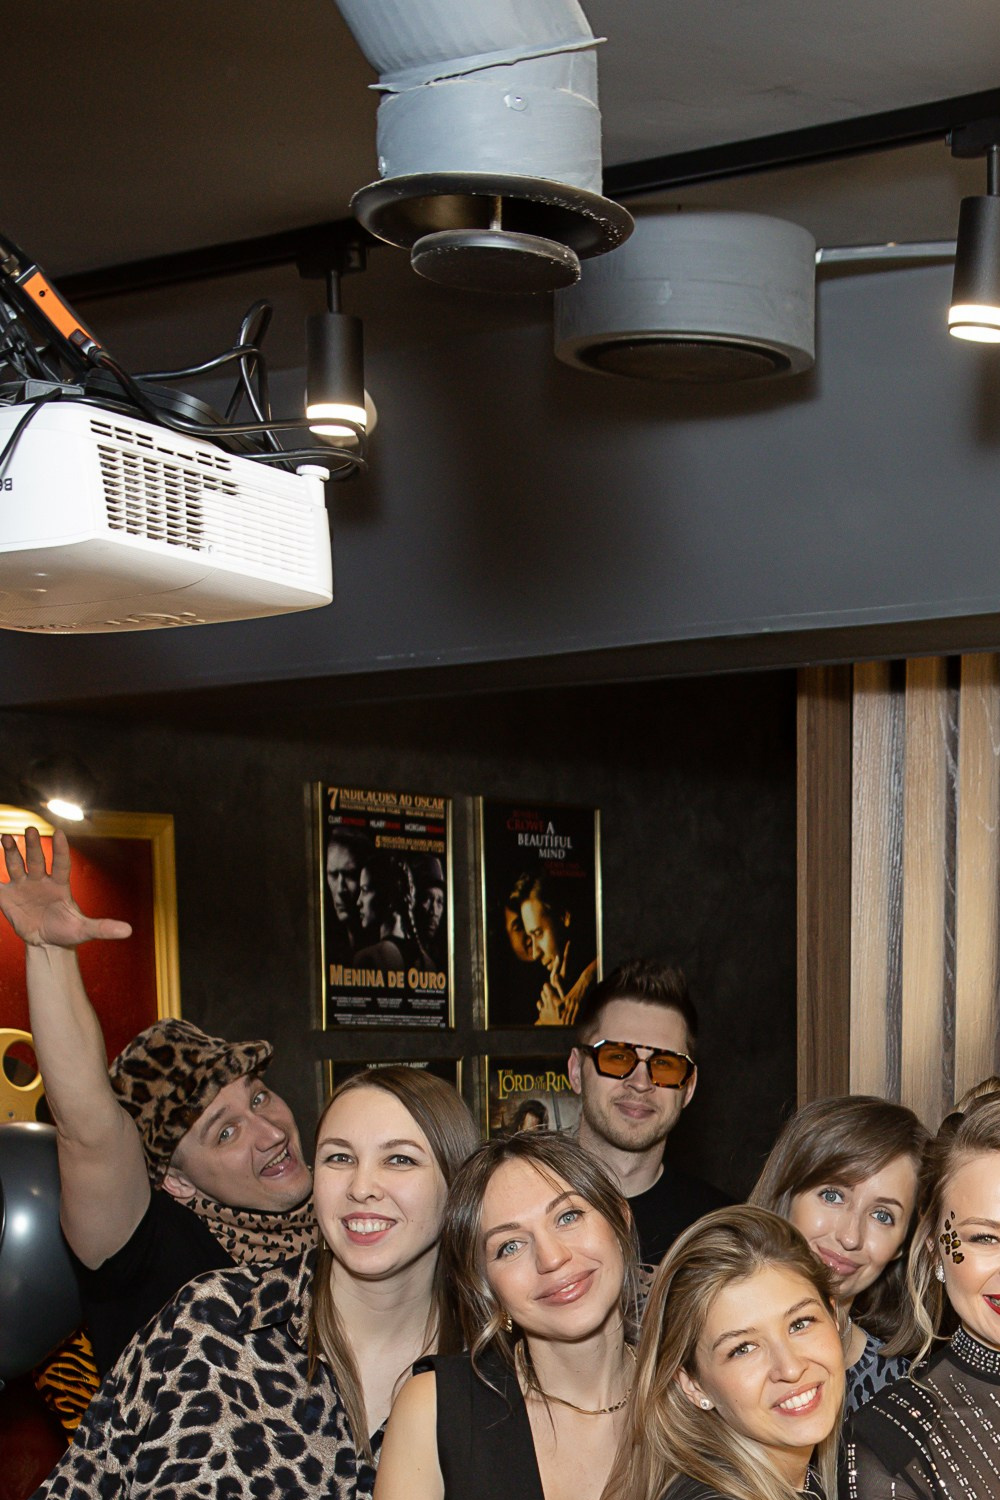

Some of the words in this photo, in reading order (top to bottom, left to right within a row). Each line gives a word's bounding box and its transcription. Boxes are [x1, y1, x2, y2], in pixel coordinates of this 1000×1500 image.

[327, 786, 340, 812] 7
[399, 793, 412, 807] AO
[414, 794, 445, 810] OSCAR
[546, 820, 555, 835] A
[517, 831, 573, 849] BEAUTIFUL
[538, 848, 566, 860] MIND
[329, 963, 385, 988] MENINA
[387, 969, 405, 988] DE
[407, 966, 447, 990] OURO
[497, 1069, 535, 1100] LORD
[545, 1071, 573, 1093] RIN
